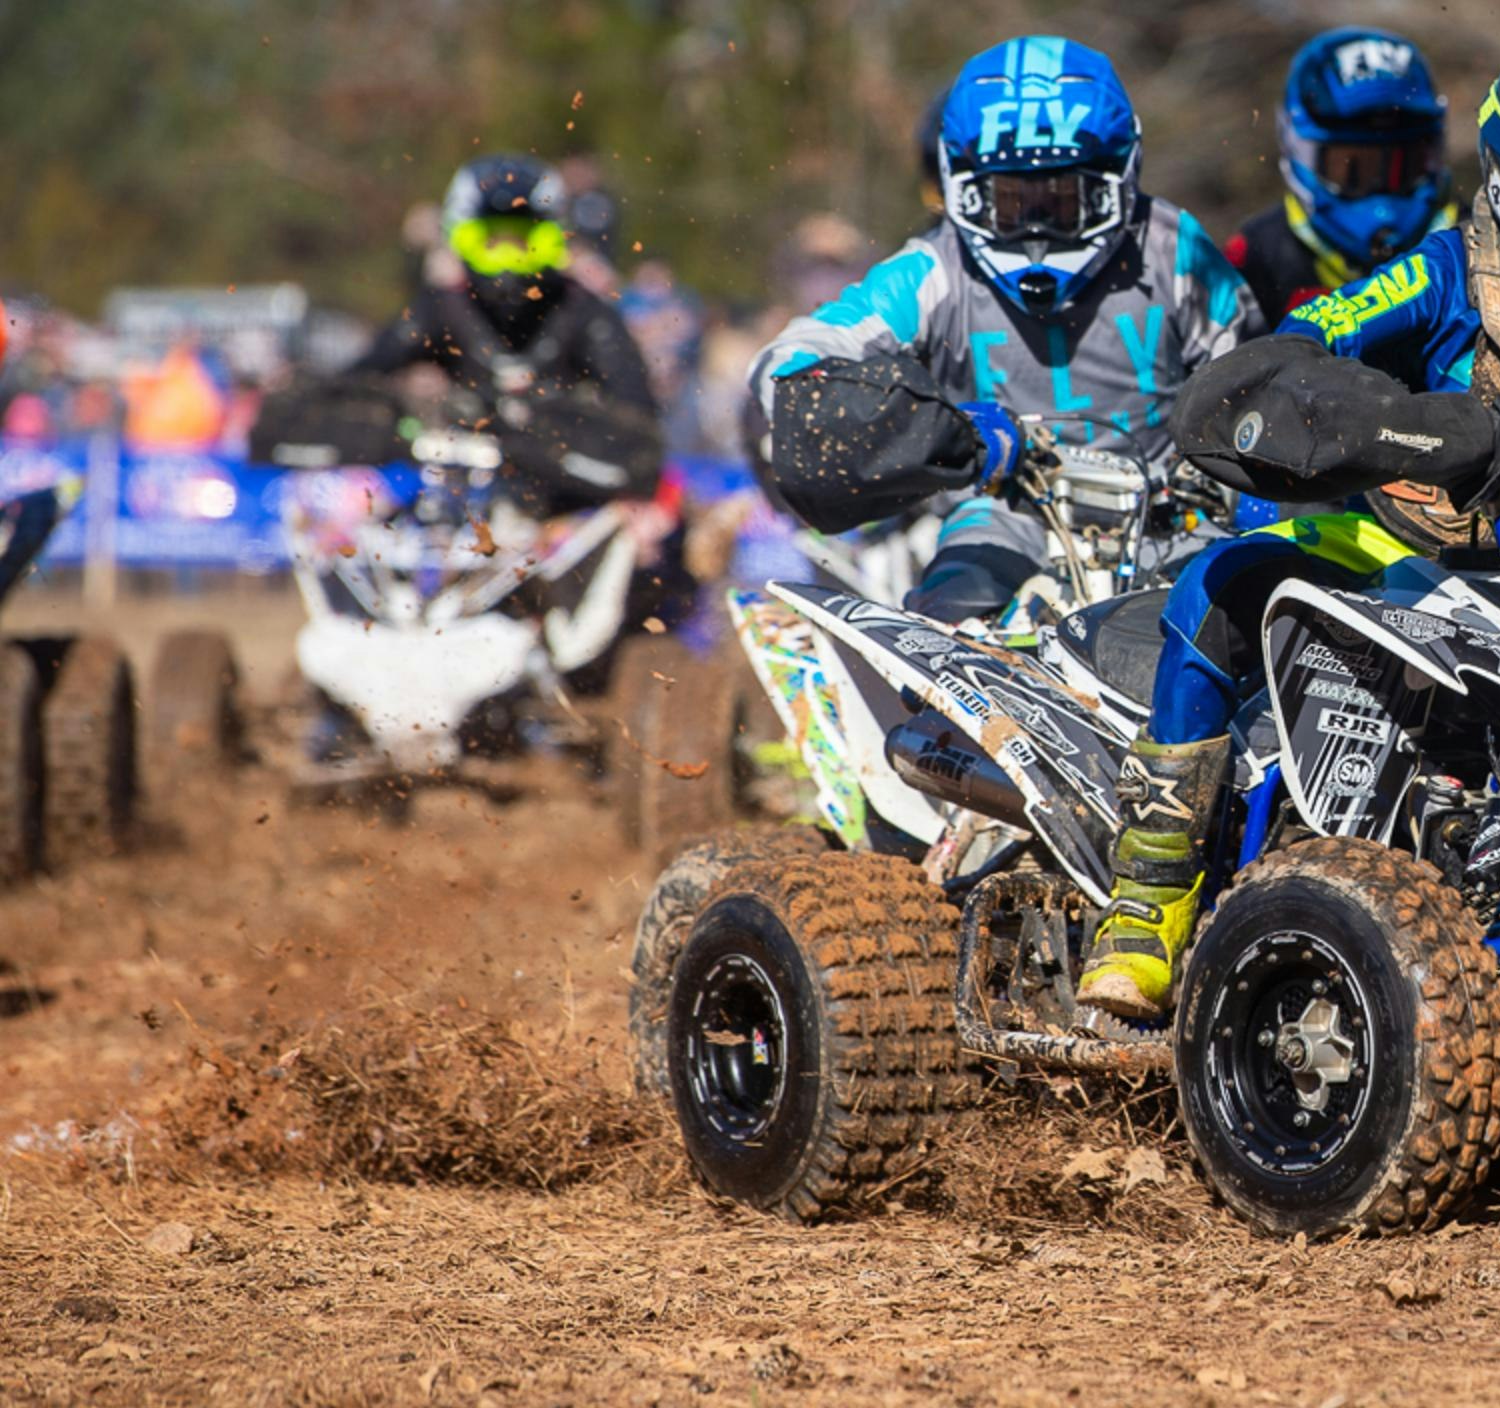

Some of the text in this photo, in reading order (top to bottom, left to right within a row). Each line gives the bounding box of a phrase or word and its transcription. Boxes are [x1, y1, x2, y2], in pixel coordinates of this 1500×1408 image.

[1336, 40, 1412, 86] FLY
[977, 98, 1092, 154] FLY
[970, 305, 1164, 412] FLY
[1304, 677, 1387, 709] MAXXI
[1327, 713, 1382, 737] RJR
[1340, 761, 1370, 784] SM
